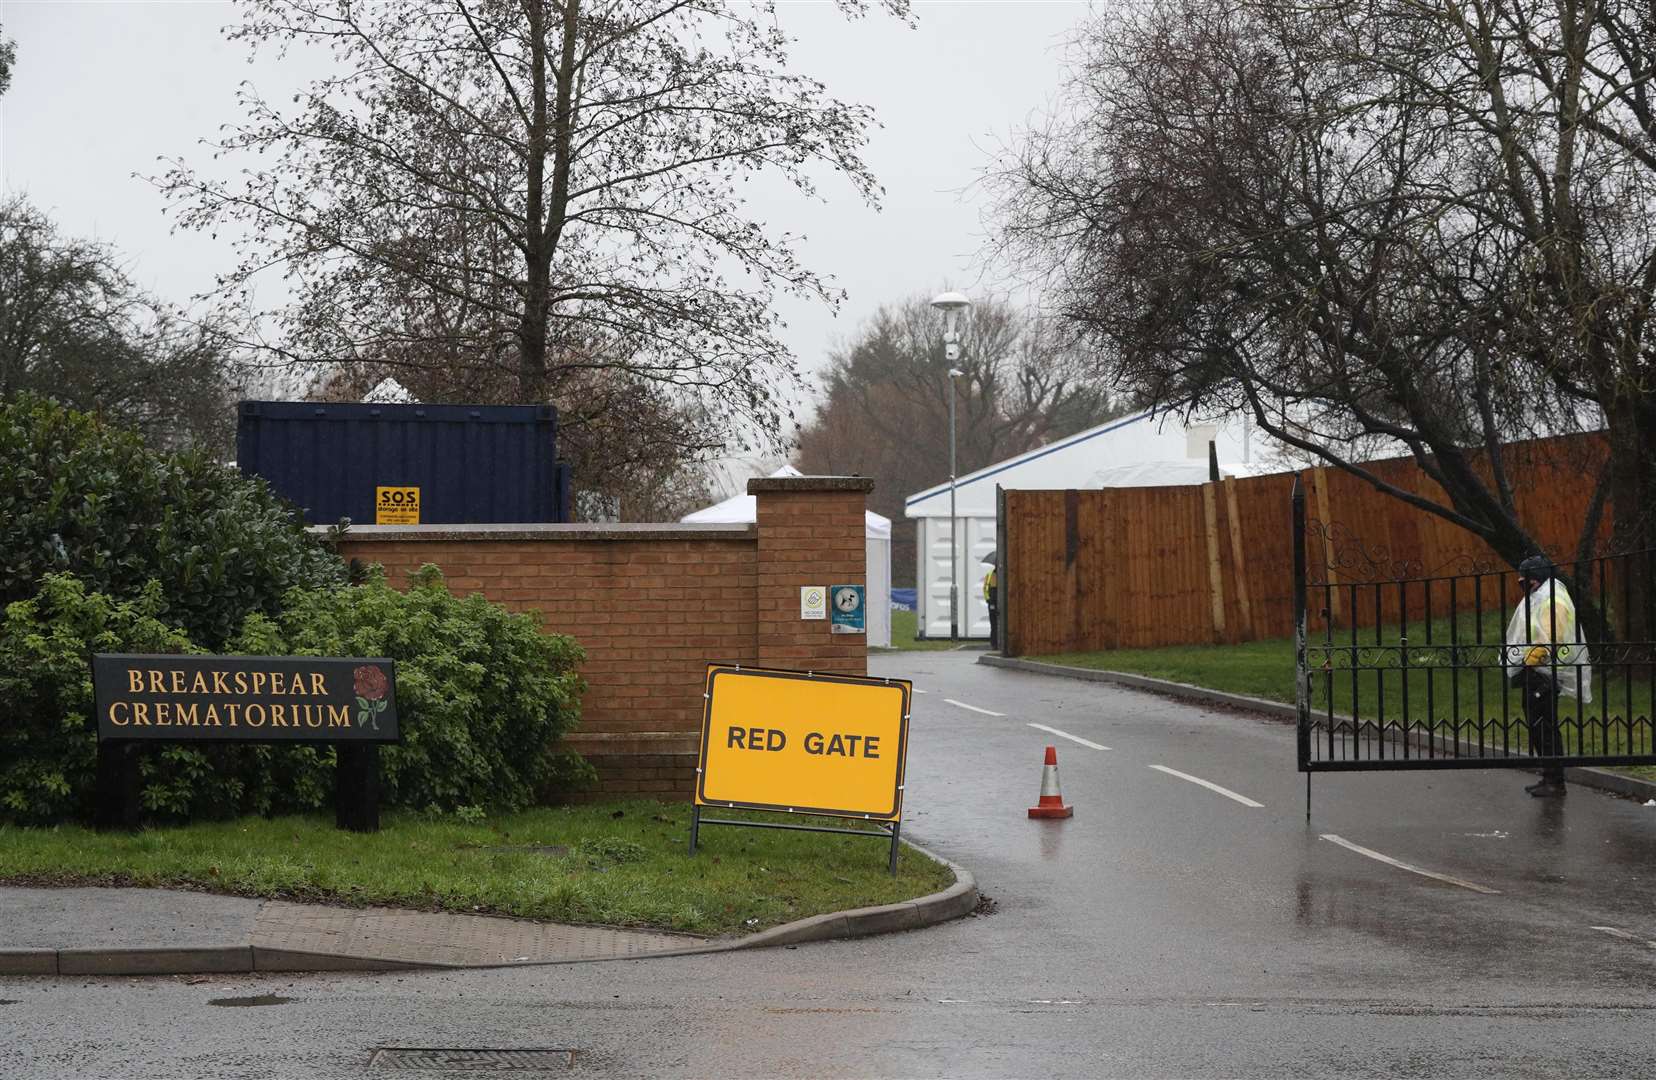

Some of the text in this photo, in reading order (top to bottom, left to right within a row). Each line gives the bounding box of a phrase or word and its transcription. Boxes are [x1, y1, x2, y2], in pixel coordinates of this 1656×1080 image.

[382, 491, 416, 503] SOS
[127, 669, 329, 696] BREAKSPEAR
[108, 701, 352, 728] CREMATORIUM
[727, 726, 880, 759] RED GATE
